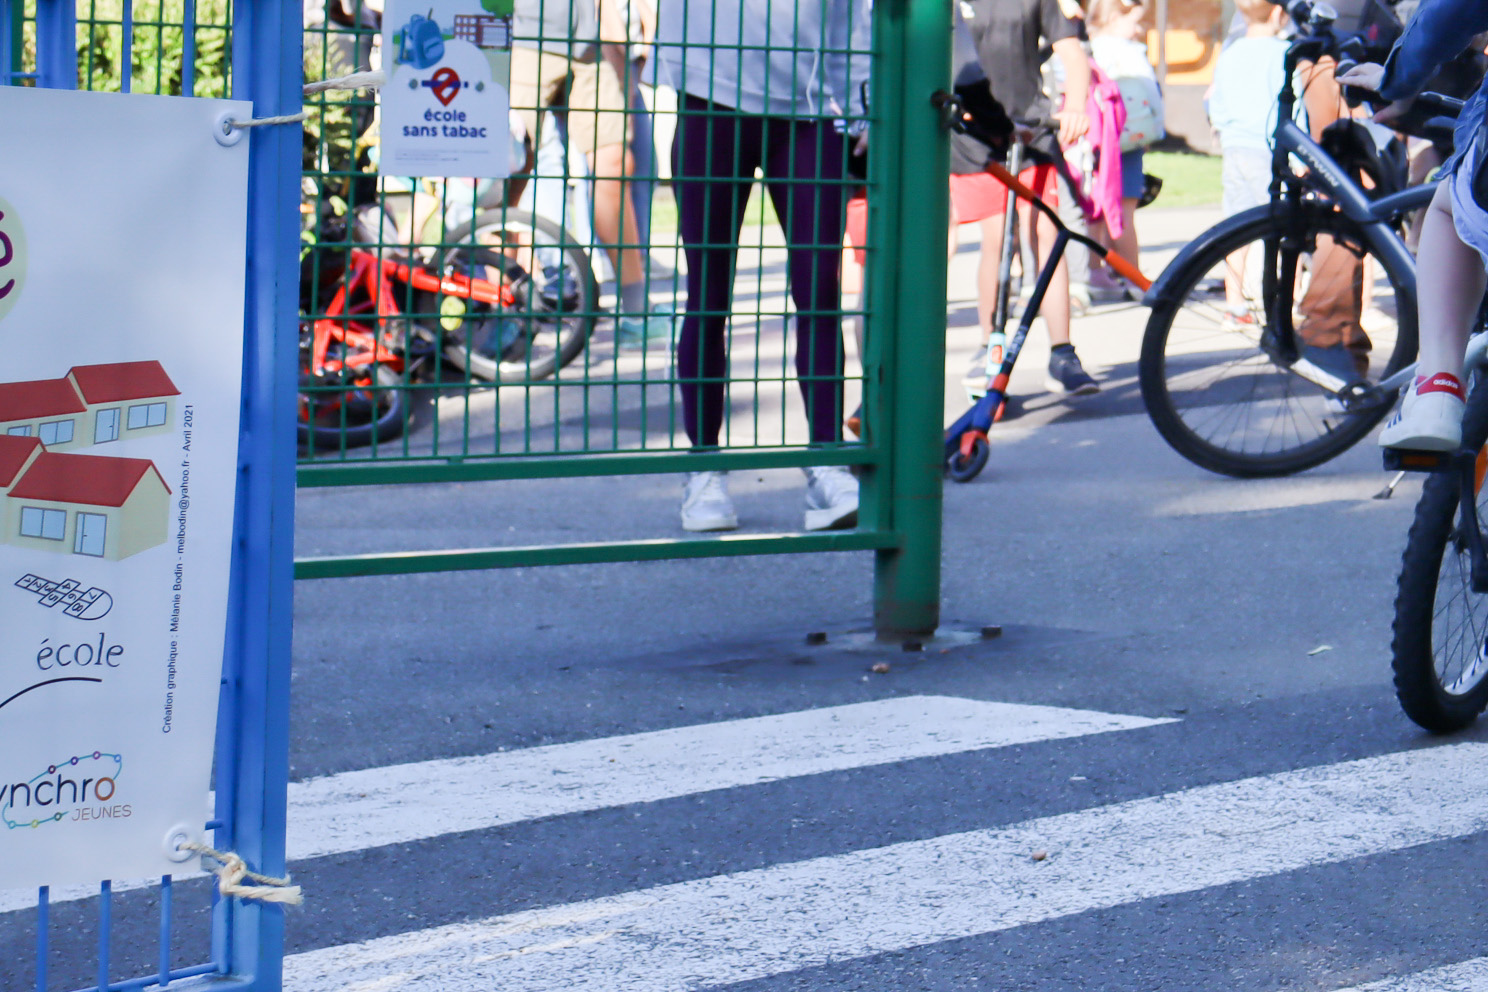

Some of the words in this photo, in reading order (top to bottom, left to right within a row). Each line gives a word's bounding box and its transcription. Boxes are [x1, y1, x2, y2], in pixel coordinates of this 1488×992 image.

[424, 108, 467, 122] école
[402, 125, 438, 137] sans
[442, 125, 487, 138] tabac
[184, 405, 193, 428] 2021
[182, 430, 192, 452] Avril
[177, 460, 190, 554] melbodin@yahoo.fr
[172, 563, 183, 591] Bodin
[169, 594, 181, 632] Mélanie
[36, 632, 124, 670] école
[167, 640, 178, 690] graphique
[162, 691, 174, 733] Création
[72, 805, 132, 821] JEUNES
